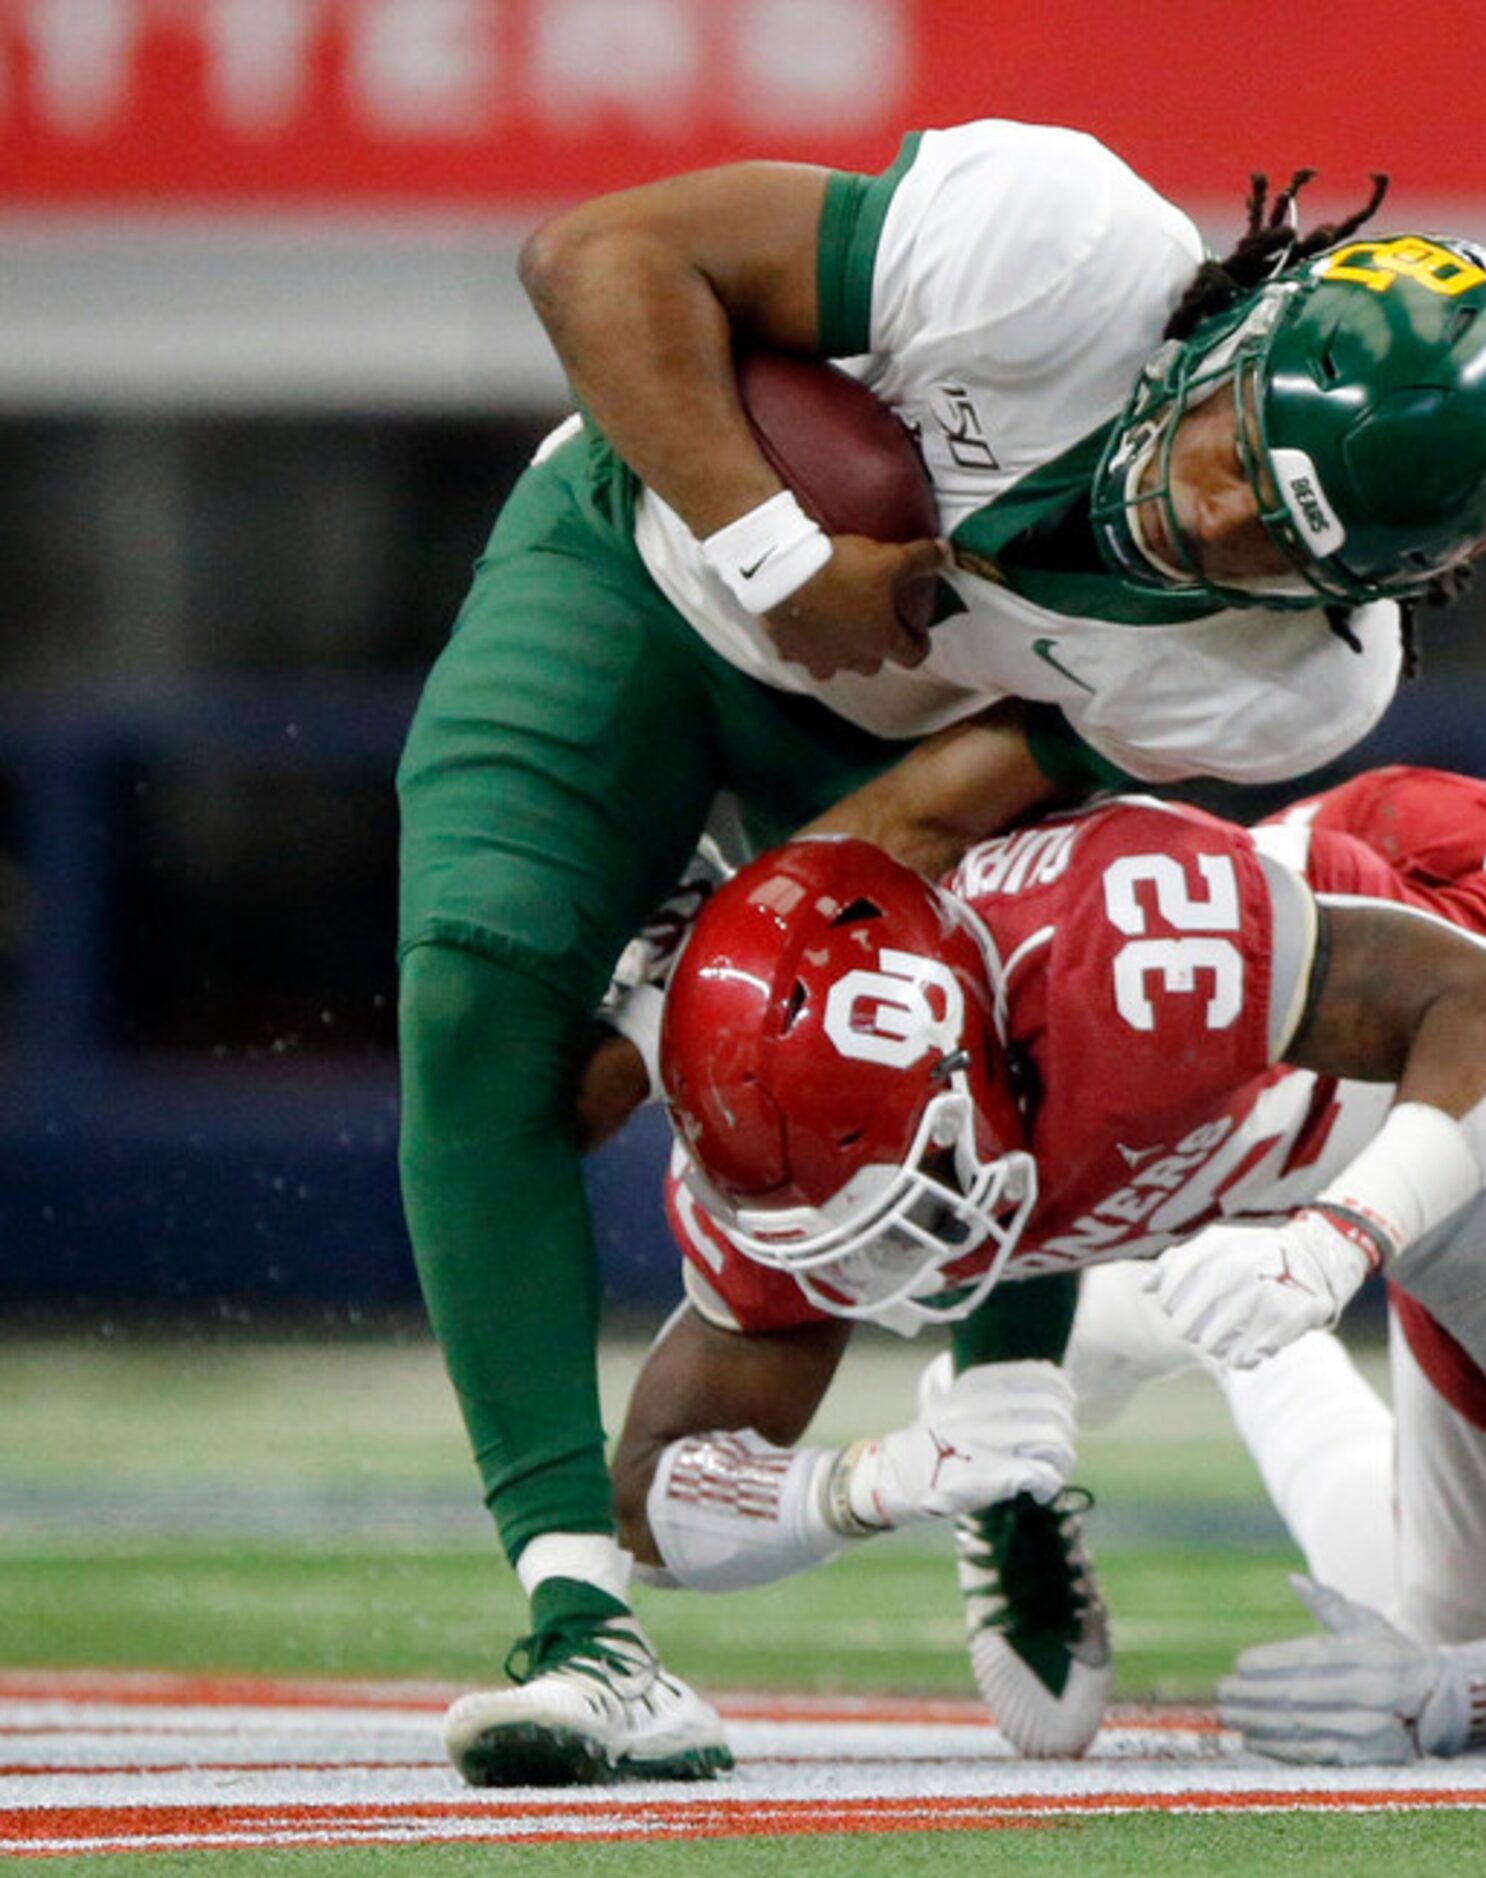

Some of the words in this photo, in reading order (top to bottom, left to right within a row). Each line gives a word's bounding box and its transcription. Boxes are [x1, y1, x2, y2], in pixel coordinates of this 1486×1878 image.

[1289, 476, 1331, 535] BEARS
[1102, 852, 1244, 1031] 32
[823, 947, 965, 1070] OU
